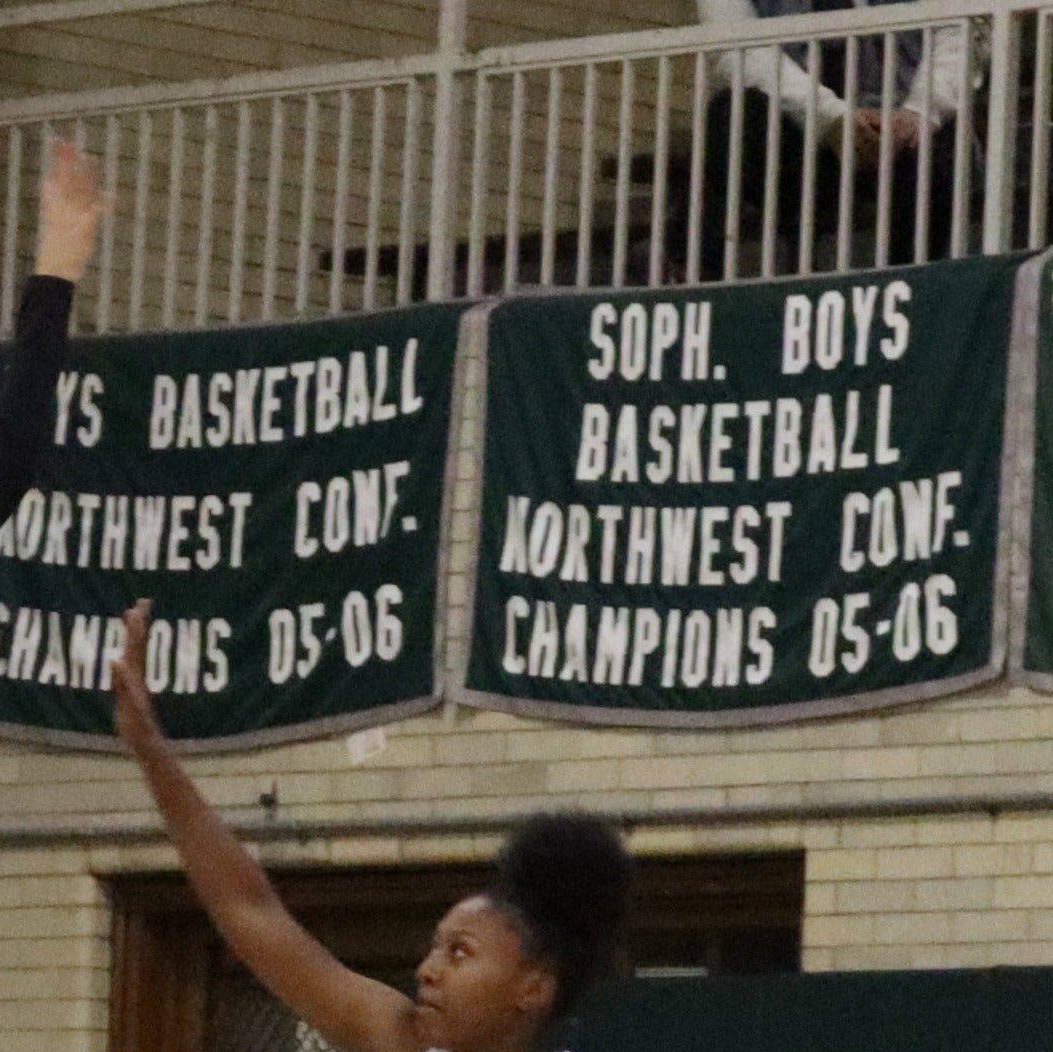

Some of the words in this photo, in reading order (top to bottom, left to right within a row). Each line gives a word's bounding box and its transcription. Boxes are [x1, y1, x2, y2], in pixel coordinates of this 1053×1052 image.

[587, 302, 726, 382] SOPH.
[781, 281, 912, 375] BOYS
[150, 338, 423, 450] BASKETBALL
[575, 384, 900, 484] BASKETBALL
[294, 460, 418, 558] CONF.
[499, 495, 792, 587] NORTHWEST
[840, 470, 970, 573] CONF.
[268, 583, 404, 685] 05-06
[501, 595, 777, 689] CHAMPIONS
[808, 574, 959, 679] 05-06
